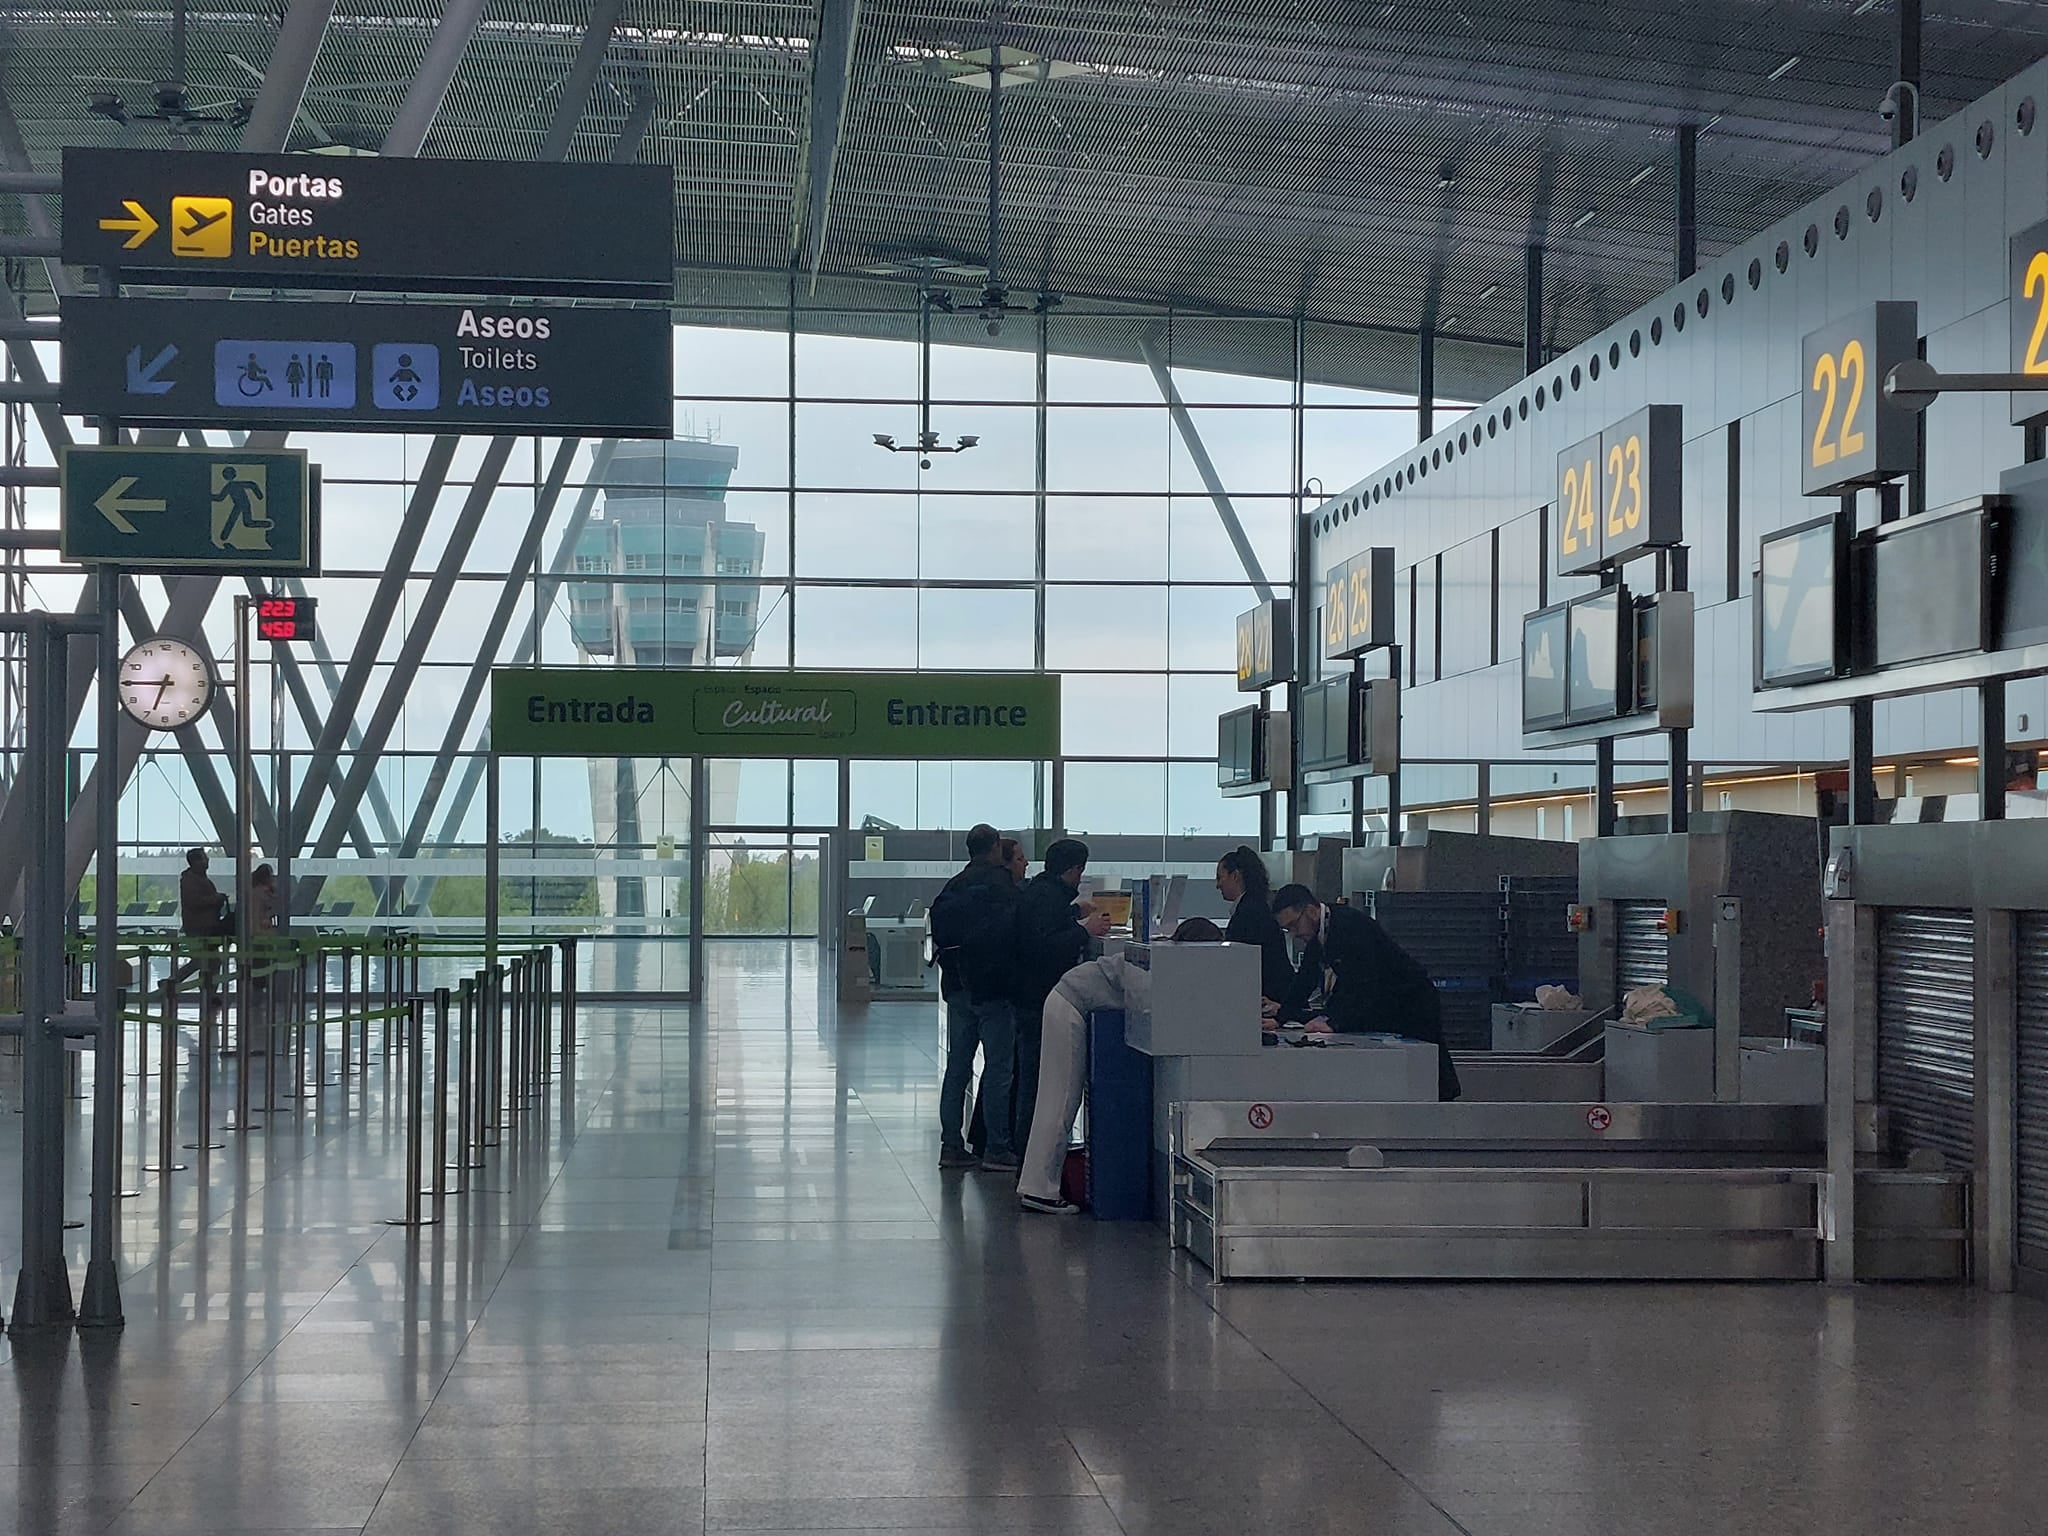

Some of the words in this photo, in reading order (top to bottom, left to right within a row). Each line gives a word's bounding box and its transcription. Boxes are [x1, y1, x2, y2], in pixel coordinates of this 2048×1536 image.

[248, 169, 343, 198] Portas
[249, 201, 313, 226] Gates
[249, 230, 359, 258] Puertas
[456, 309, 551, 339] Aseos
[458, 346, 537, 370] Toilets
[457, 378, 551, 408] Aseos
[1812, 339, 1864, 468] 22
[1608, 435, 1641, 537] 23
[1563, 459, 1594, 555] 24
[1328, 577, 1345, 645] 26
[1350, 567, 1368, 637] 25
[1238, 624, 1251, 681] 28
[1256, 621, 1269, 673] 27
[143, 711, 150, 719] 7
[527, 695, 655, 723] Entrada
[722, 698, 833, 728] Cultural
[887, 699, 1027, 727] Entrance
